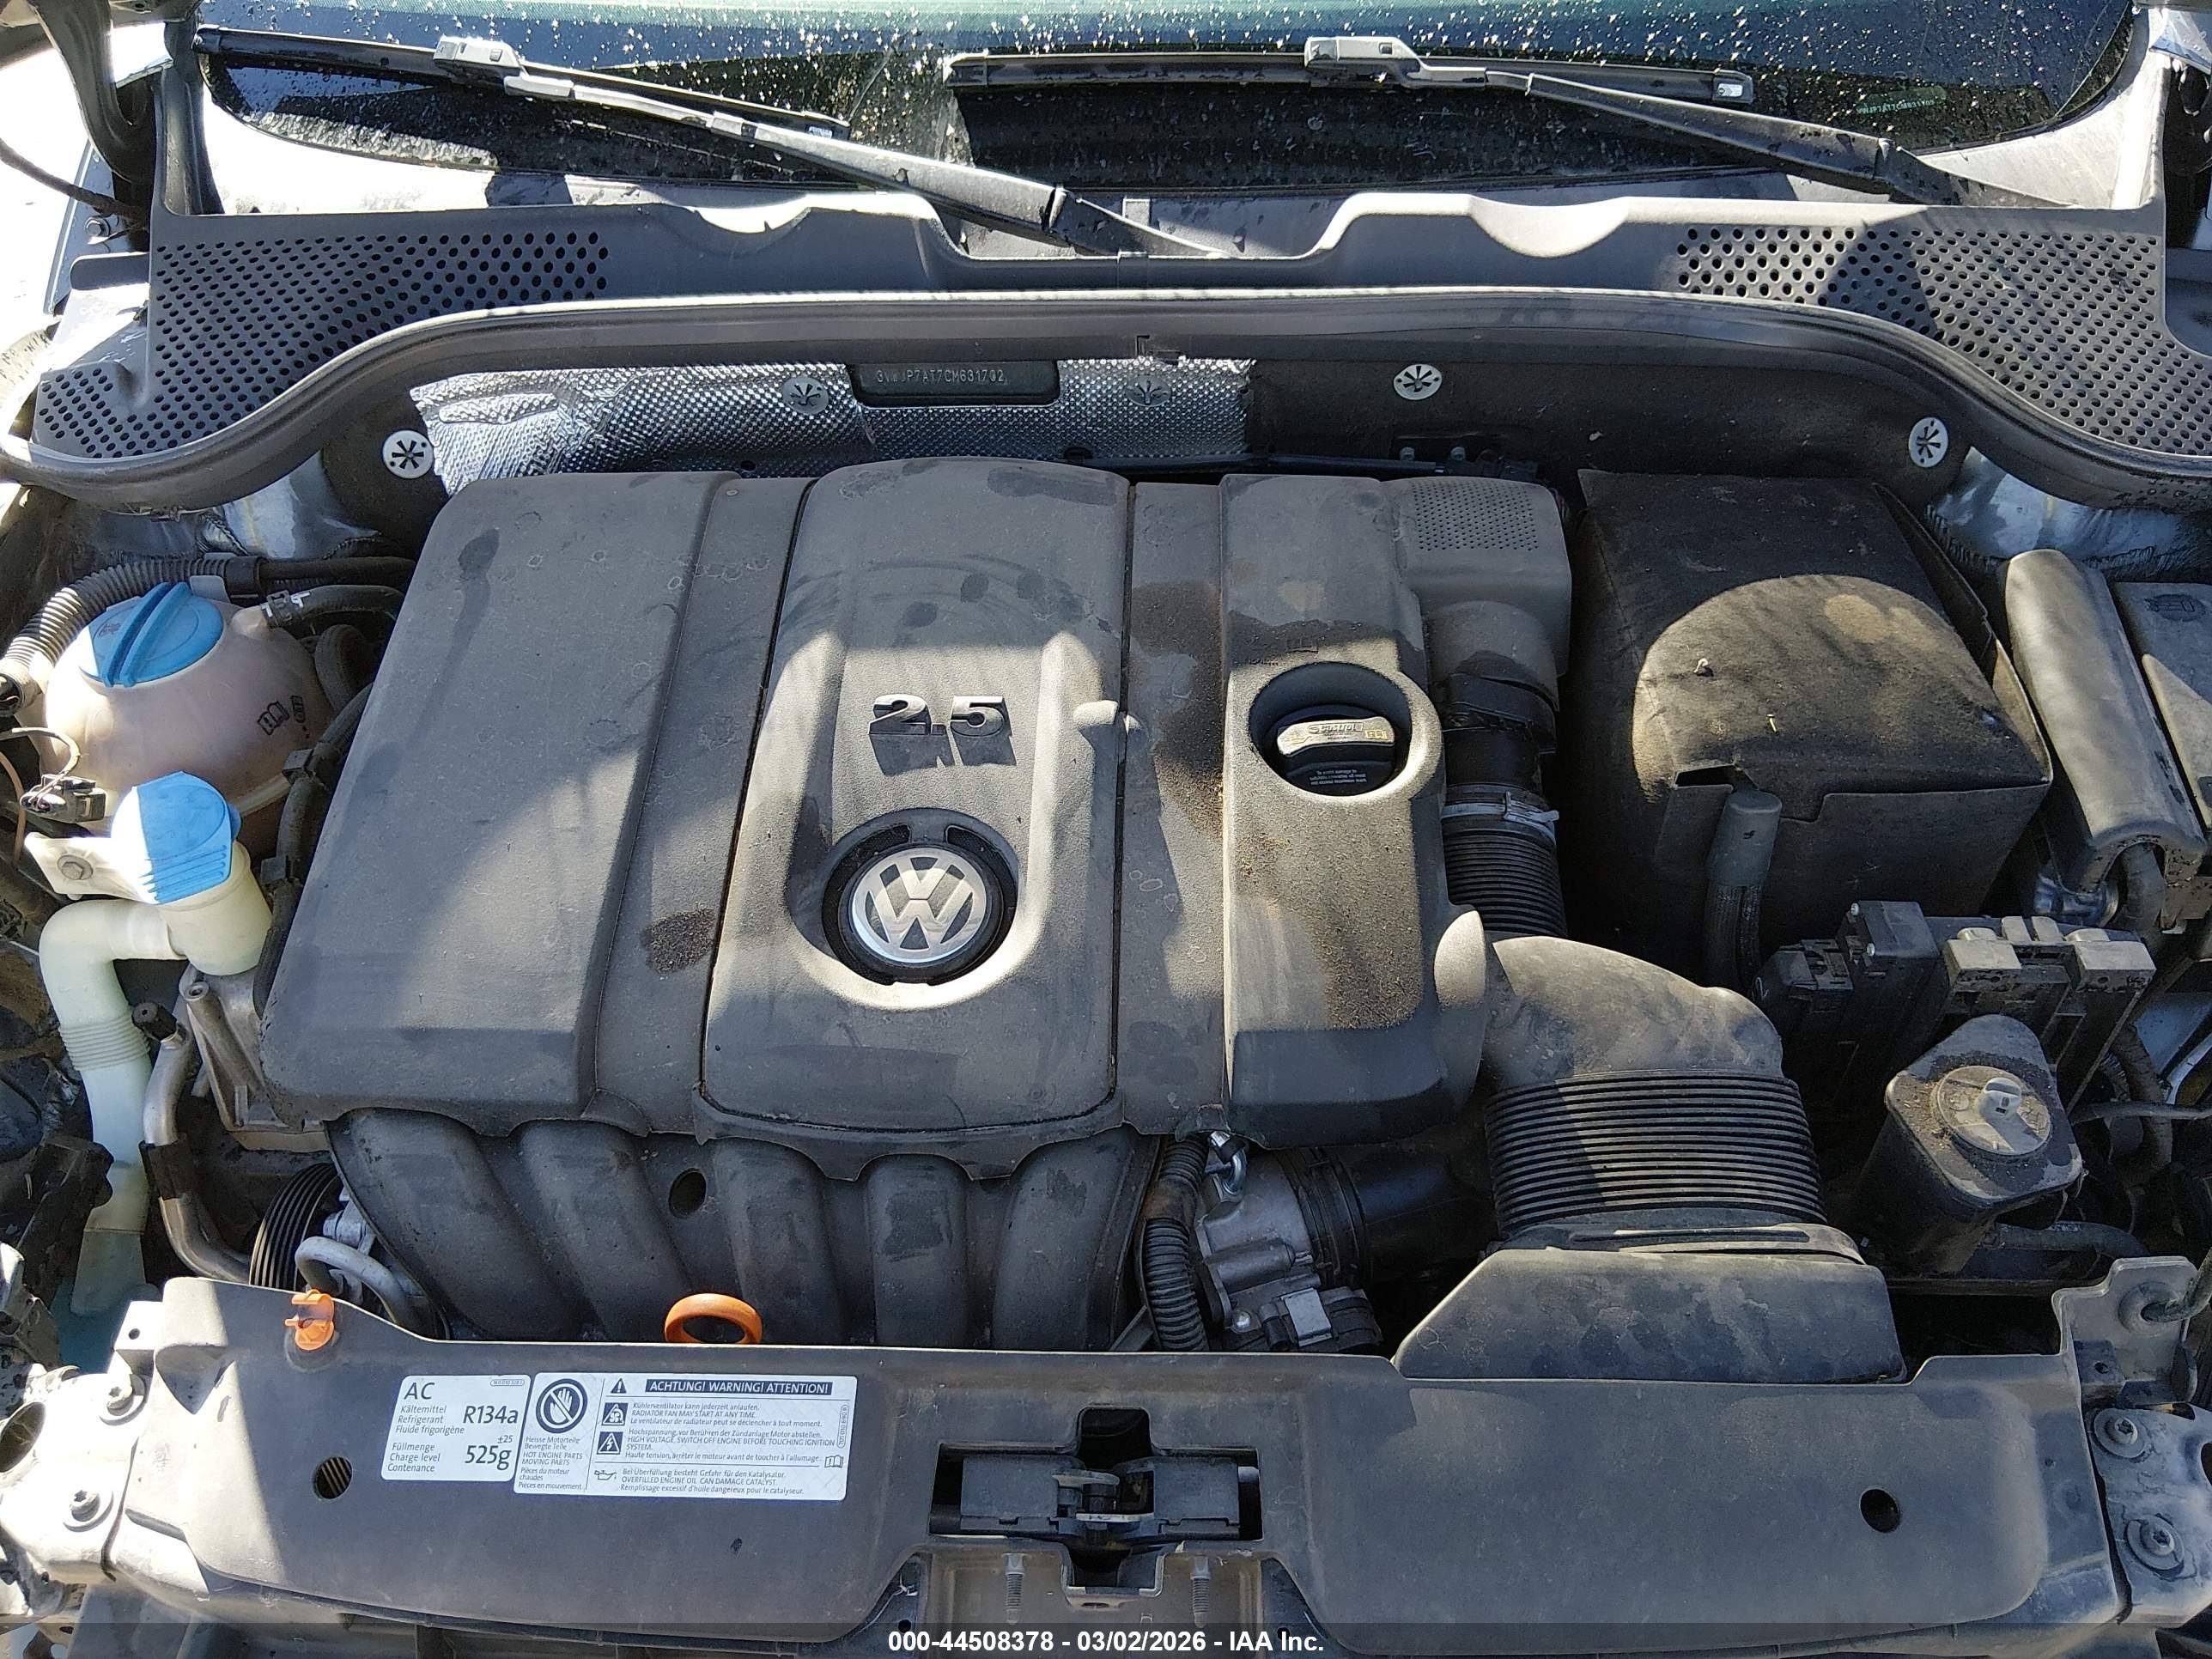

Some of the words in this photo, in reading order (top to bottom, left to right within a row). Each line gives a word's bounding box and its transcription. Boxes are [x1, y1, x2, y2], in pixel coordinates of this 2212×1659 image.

[868, 694, 1012, 737] 2.5
[404, 1382, 435, 1400] AC
[649, 1381, 706, 1392] ACHTUNG!
[708, 1381, 764, 1393] WARNING!
[766, 1382, 829, 1394] ATTENTION!
[400, 1405, 447, 1413] Kältemittel
[701, 1402, 728, 1411] jederzeit
[463, 1405, 519, 1424] R134a
[398, 1415, 443, 1425] Refrigerant
[395, 1425, 419, 1434] Fluide
[421, 1425, 465, 1436] frigorigène
[732, 1430, 769, 1438] Zündanlage
[497, 1435, 513, 1443] ±25
[392, 1443, 435, 1453] Füllmenge
[389, 1453, 419, 1463] Charge
[422, 1453, 441, 1462] level
[465, 1445, 512, 1470] 525g
[387, 1463, 435, 1472] Contenance
[634, 1468, 672, 1477] Überfüllung
[620, 1484, 660, 1492] Remplissage
[711, 1486, 744, 1494] dangereux
